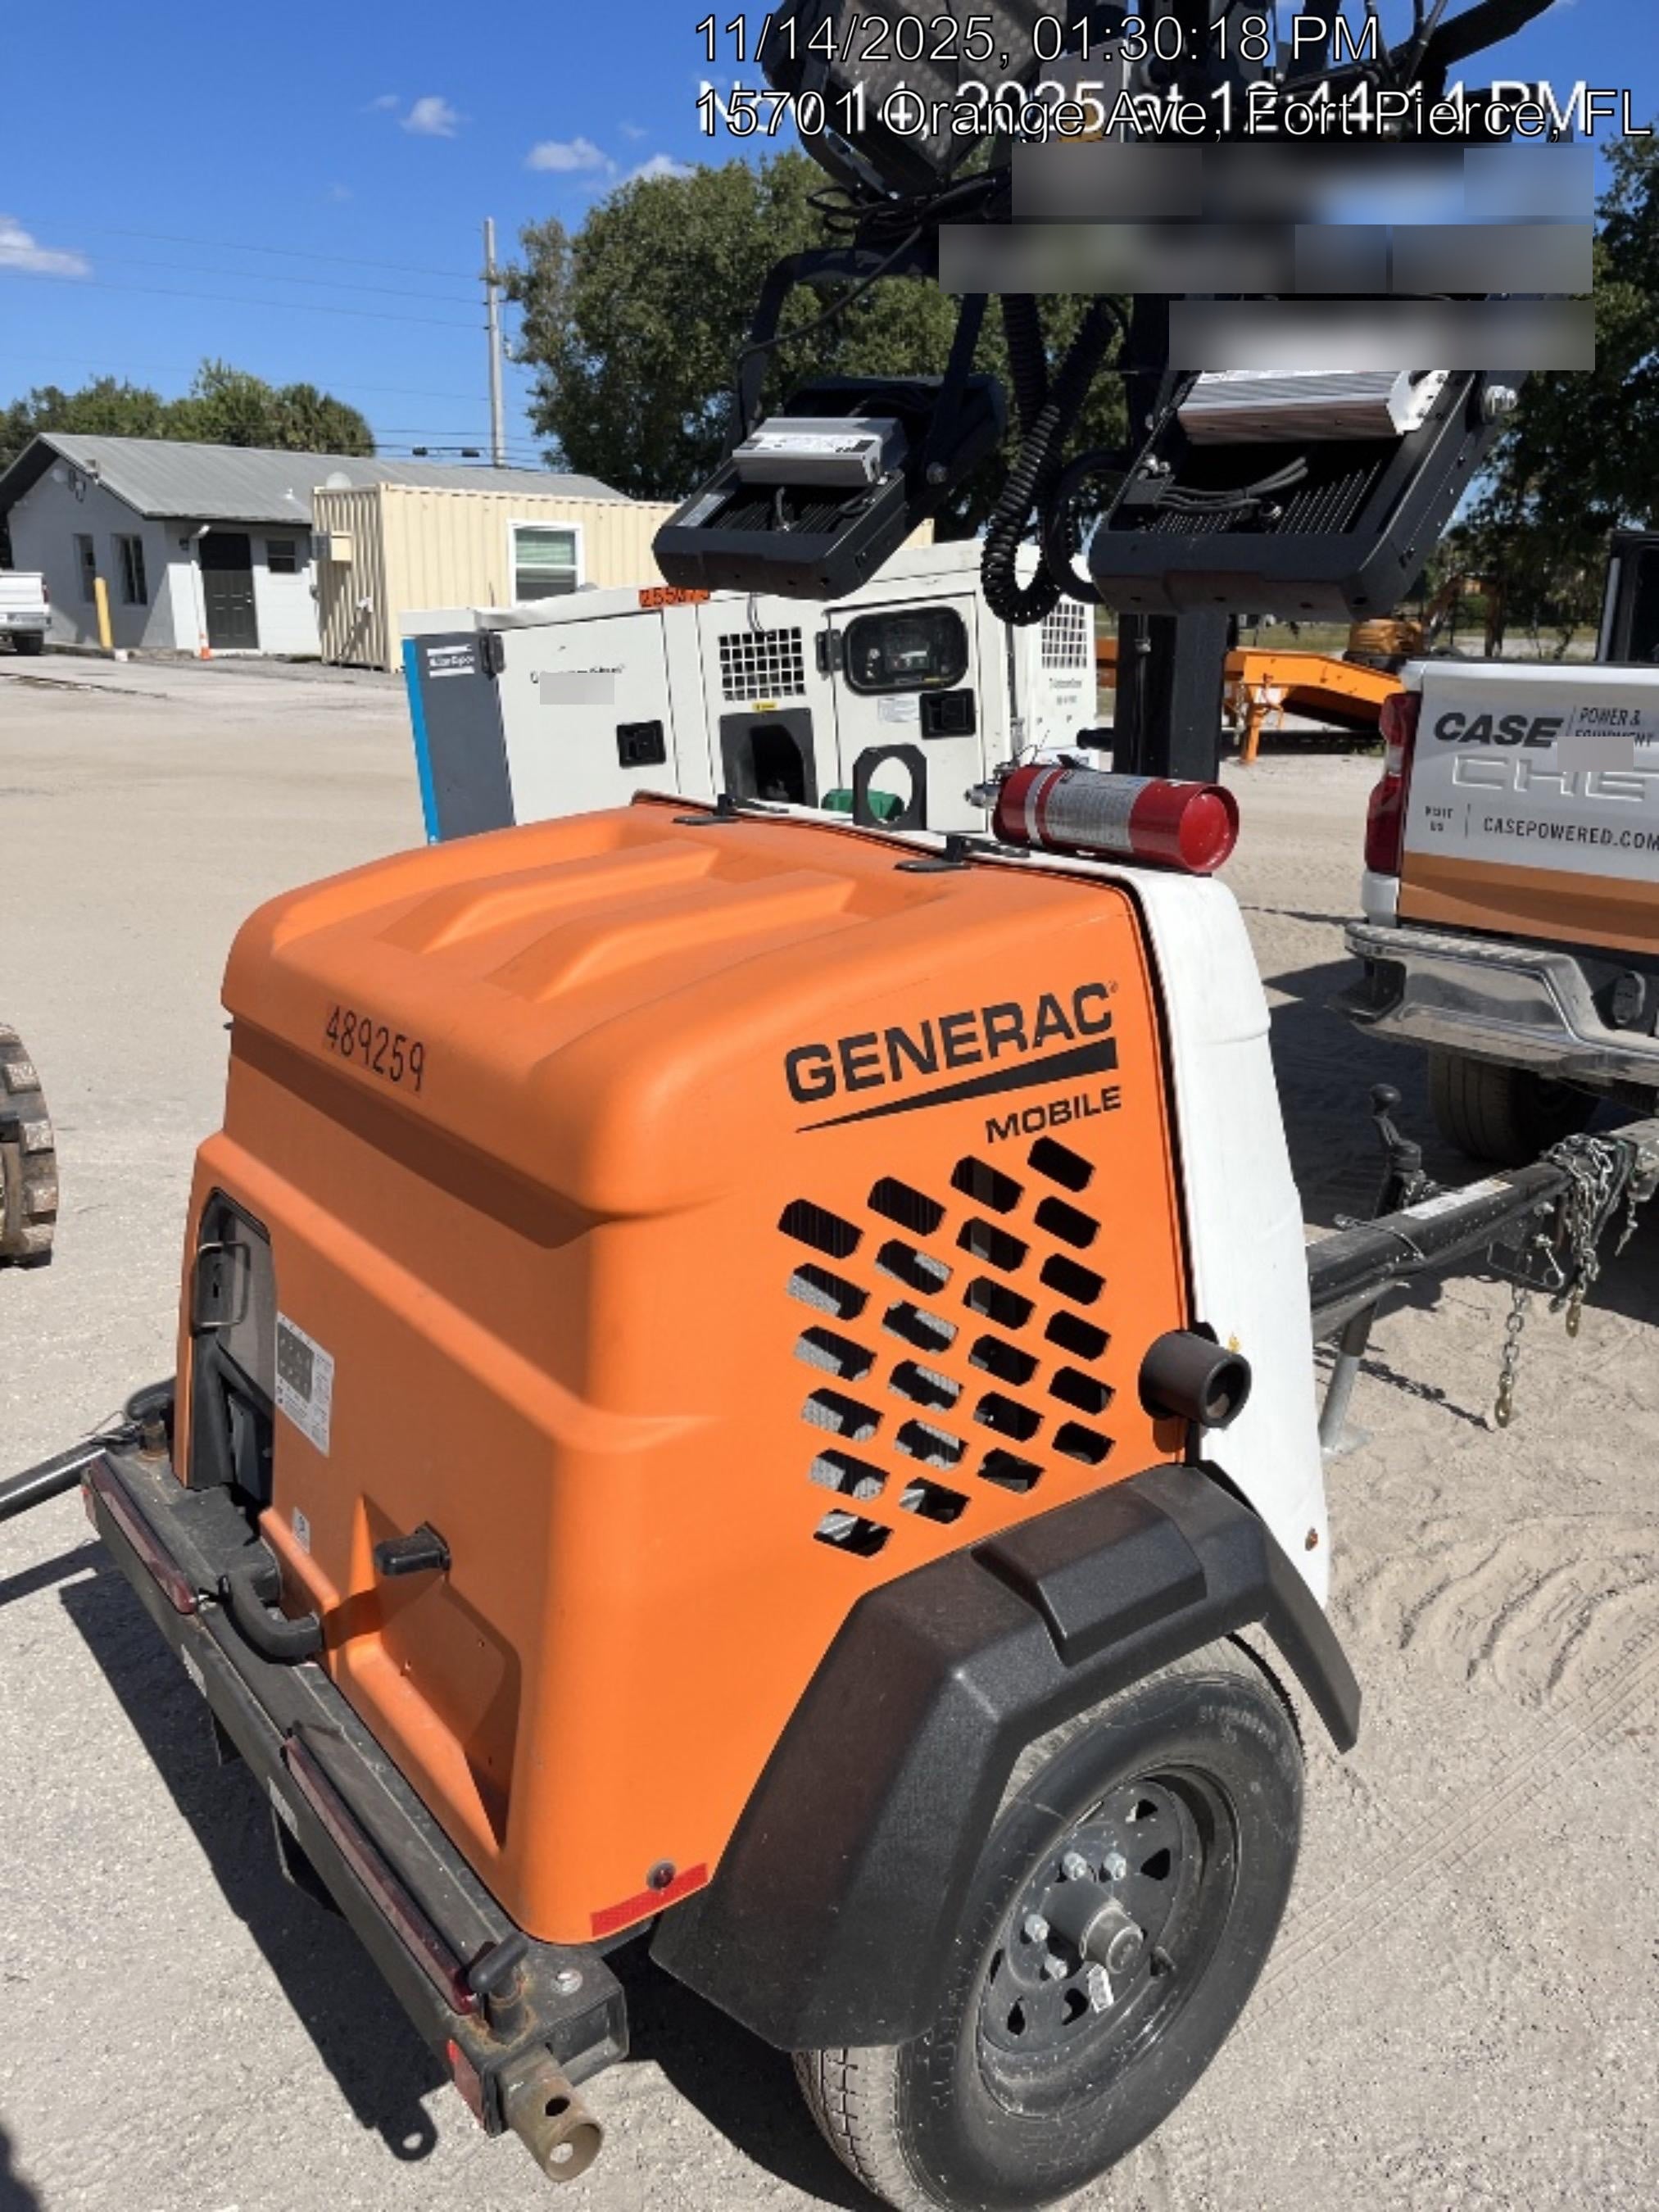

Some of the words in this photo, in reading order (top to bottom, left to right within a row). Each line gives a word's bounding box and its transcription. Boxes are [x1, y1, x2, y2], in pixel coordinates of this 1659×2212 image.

[1435, 712, 1564, 747] CASE
[1579, 707, 1629, 726] POWER
[1484, 818, 1659, 850] CASEPOWERED.COM
[326, 1005, 424, 1092] 489259
[785, 983, 1112, 1104] GENERAC
[985, 1086, 1122, 1144] MOBILE
